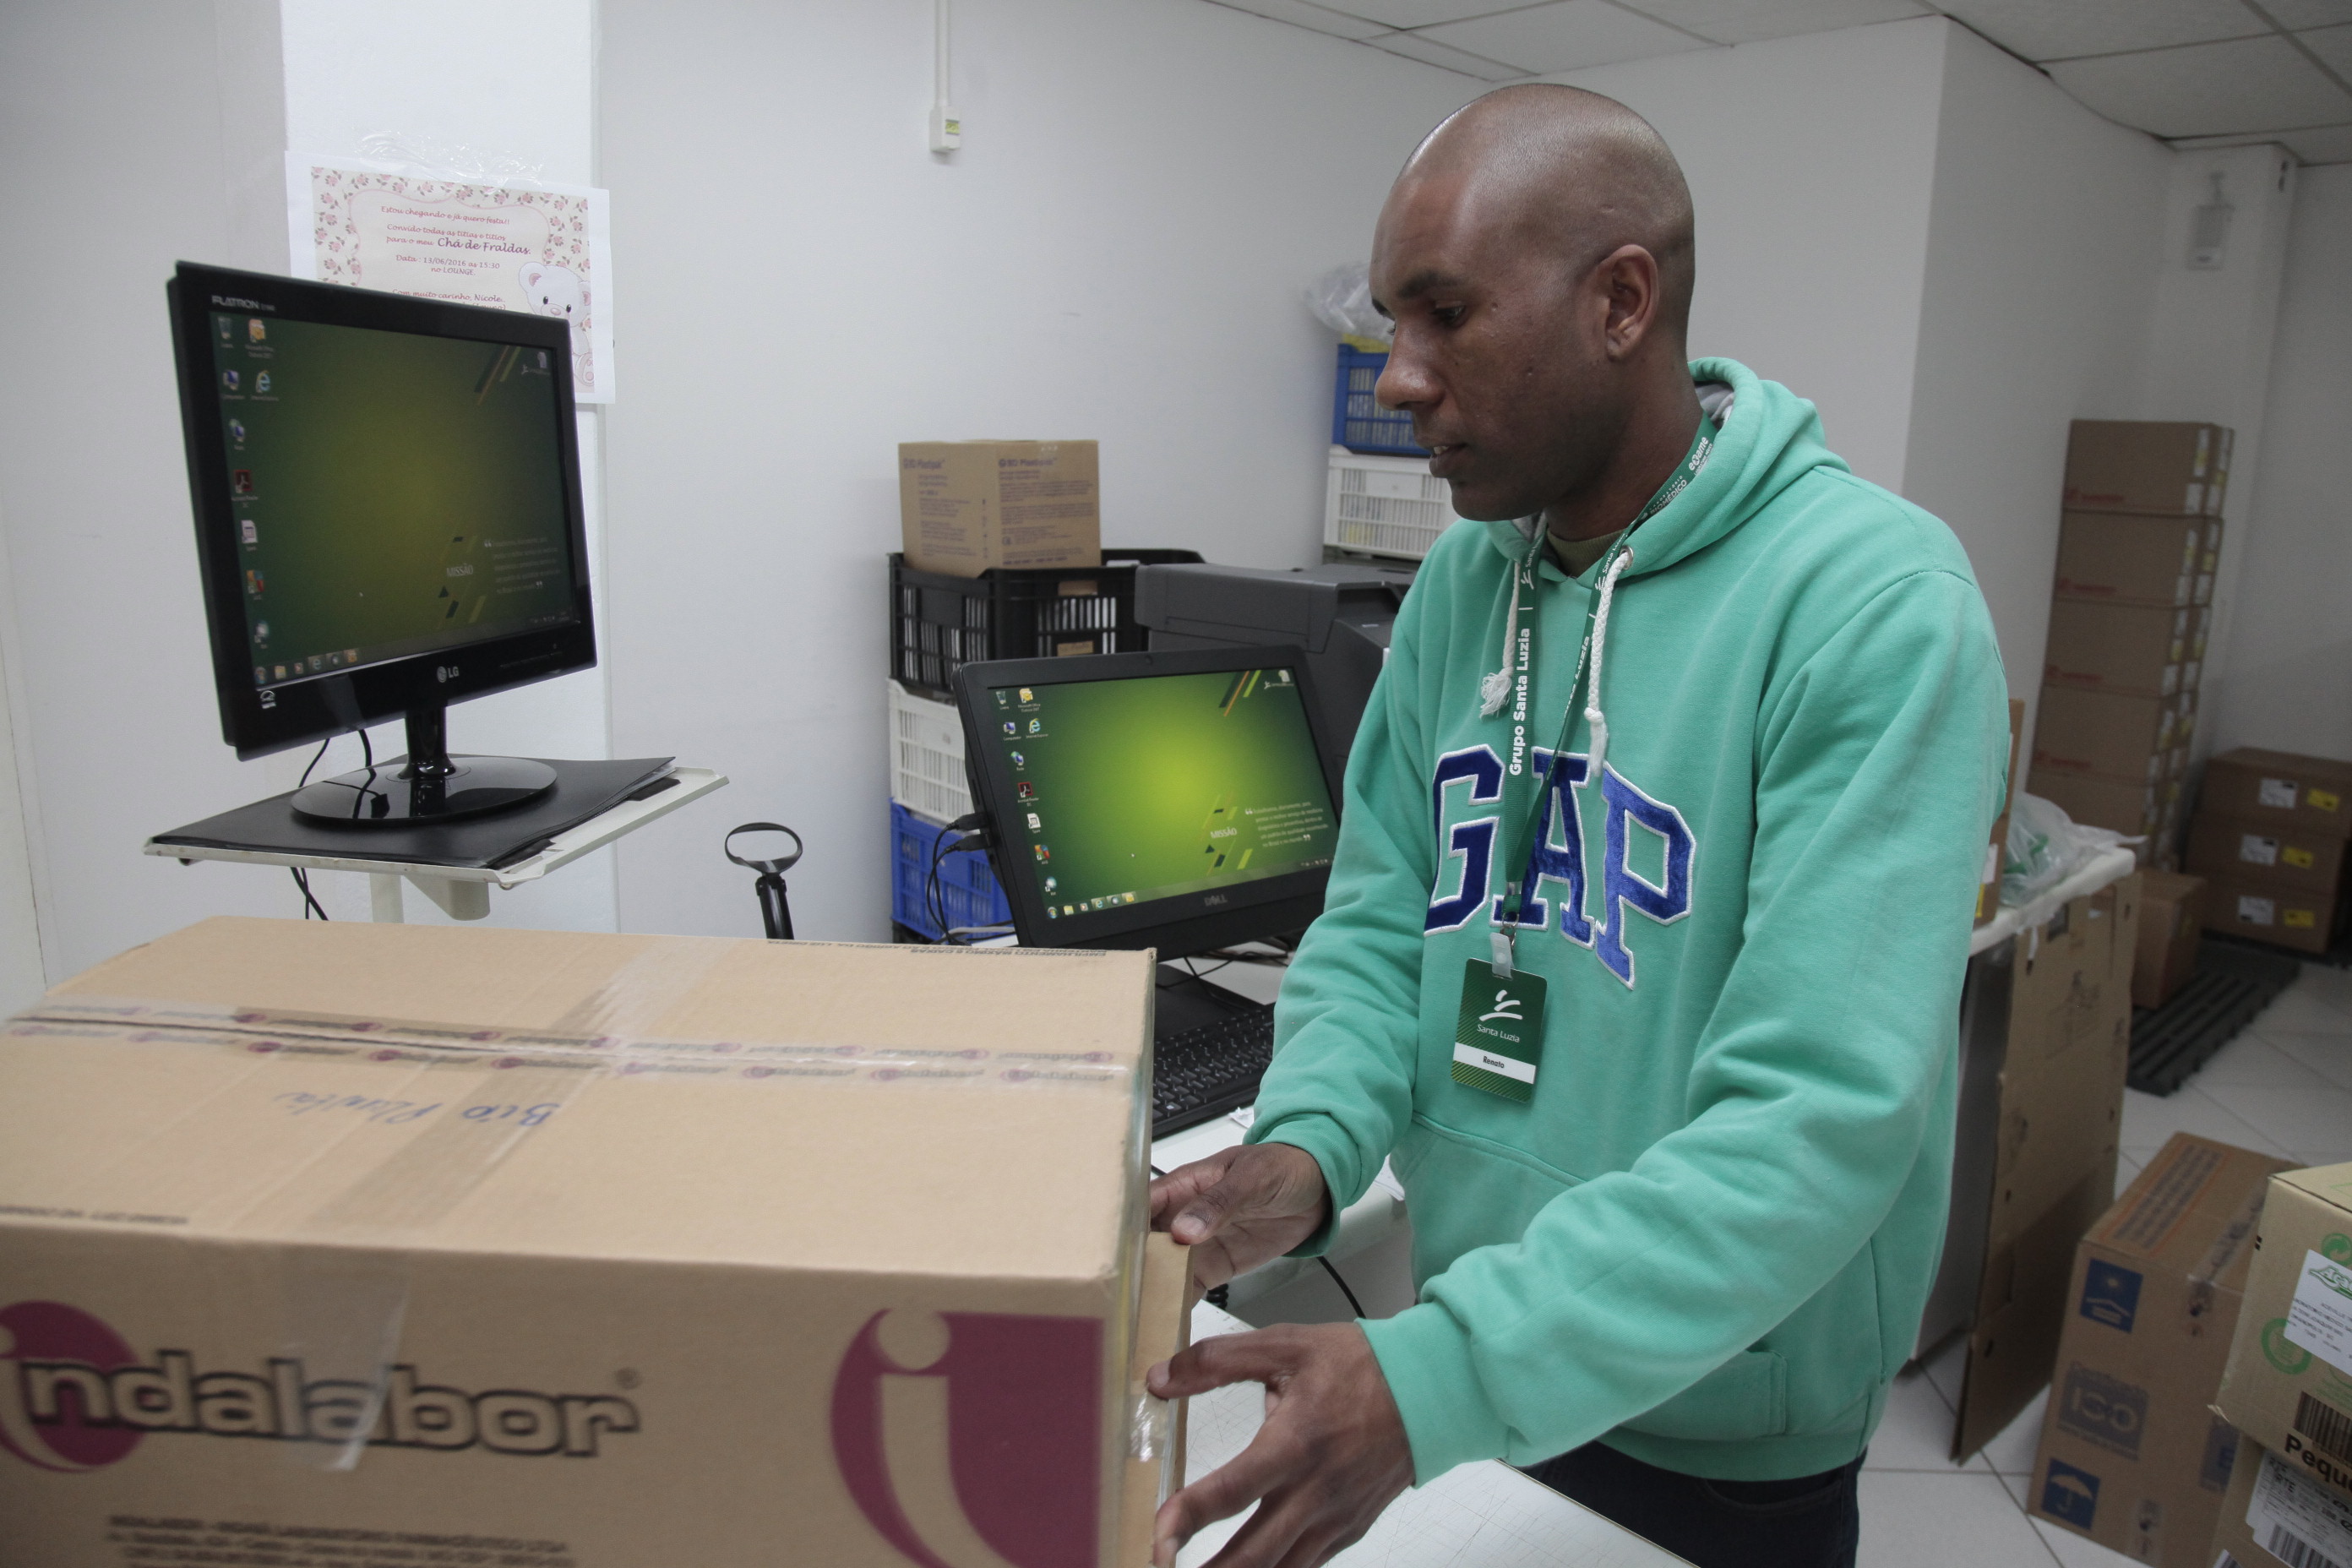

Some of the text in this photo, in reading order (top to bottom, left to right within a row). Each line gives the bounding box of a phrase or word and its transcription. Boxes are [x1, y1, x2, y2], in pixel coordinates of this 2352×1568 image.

[381, 205, 405, 215] Estou
[406, 208, 446, 219] chegando
[463, 216, 486, 225] quero
[387, 223, 422, 233] Convido
[422, 227, 445, 236] todas
[386, 236, 408, 244] para
[438, 237, 464, 248] Chá
[465, 240, 482, 251] de
[483, 242, 531, 255] Fraldas.
[423, 257, 466, 267] 13/06/2016
[1603, 553, 1614, 574] Santa
[1509, 628, 1531, 776] Grupo Santa Luzia
[1210, 826, 1238, 839] MISSÃO
[1424, 743, 1696, 991] GAP
[1204, 893, 1228, 906] DELL
[1477, 1023, 1520, 1043] Santa Luzia
[1482, 1055, 1505, 1070] Renato
